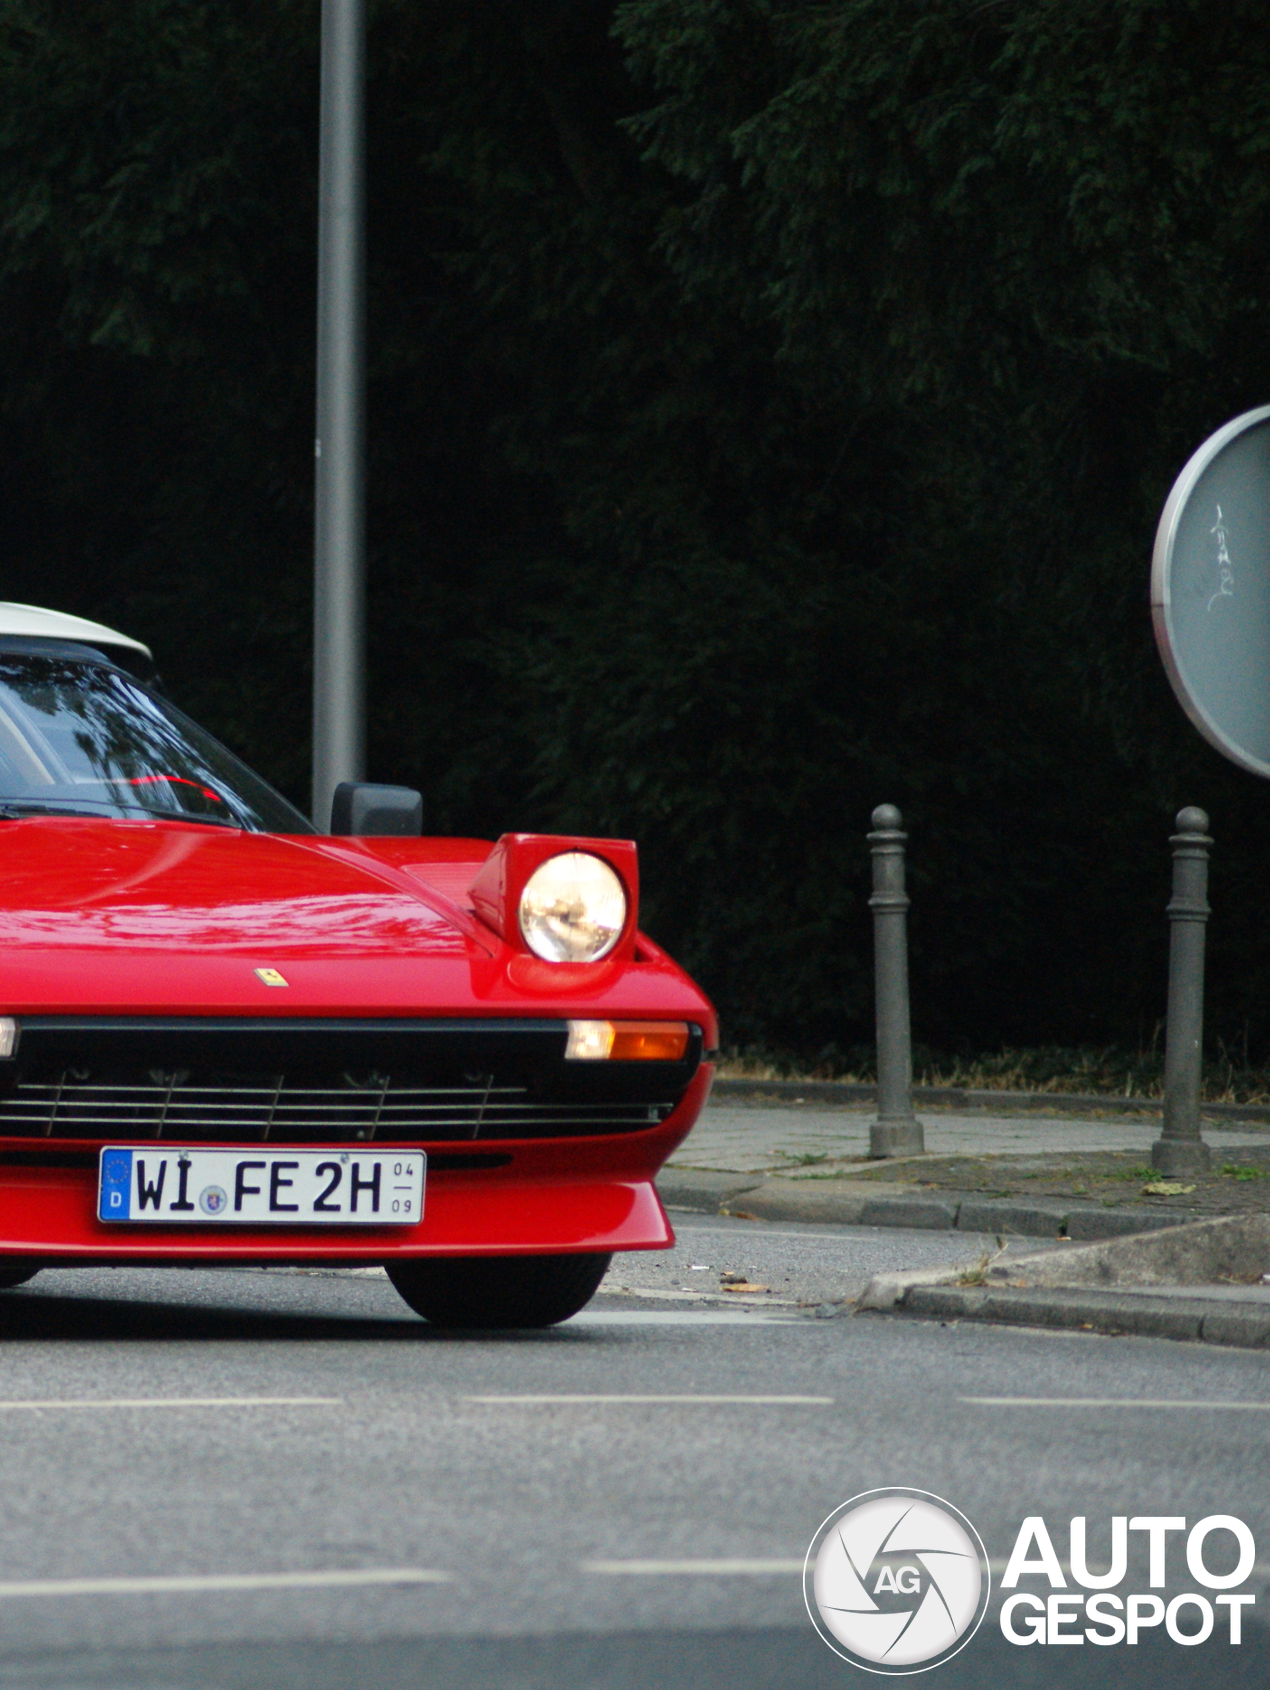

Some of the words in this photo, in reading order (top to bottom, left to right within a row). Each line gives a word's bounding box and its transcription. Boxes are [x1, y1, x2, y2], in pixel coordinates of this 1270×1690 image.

[393, 1161, 414, 1177] 04
[136, 1159, 195, 1212] WI
[234, 1160, 300, 1212] FE
[313, 1161, 382, 1213] 2H
[110, 1191, 122, 1208] D
[391, 1199, 413, 1213] 09
